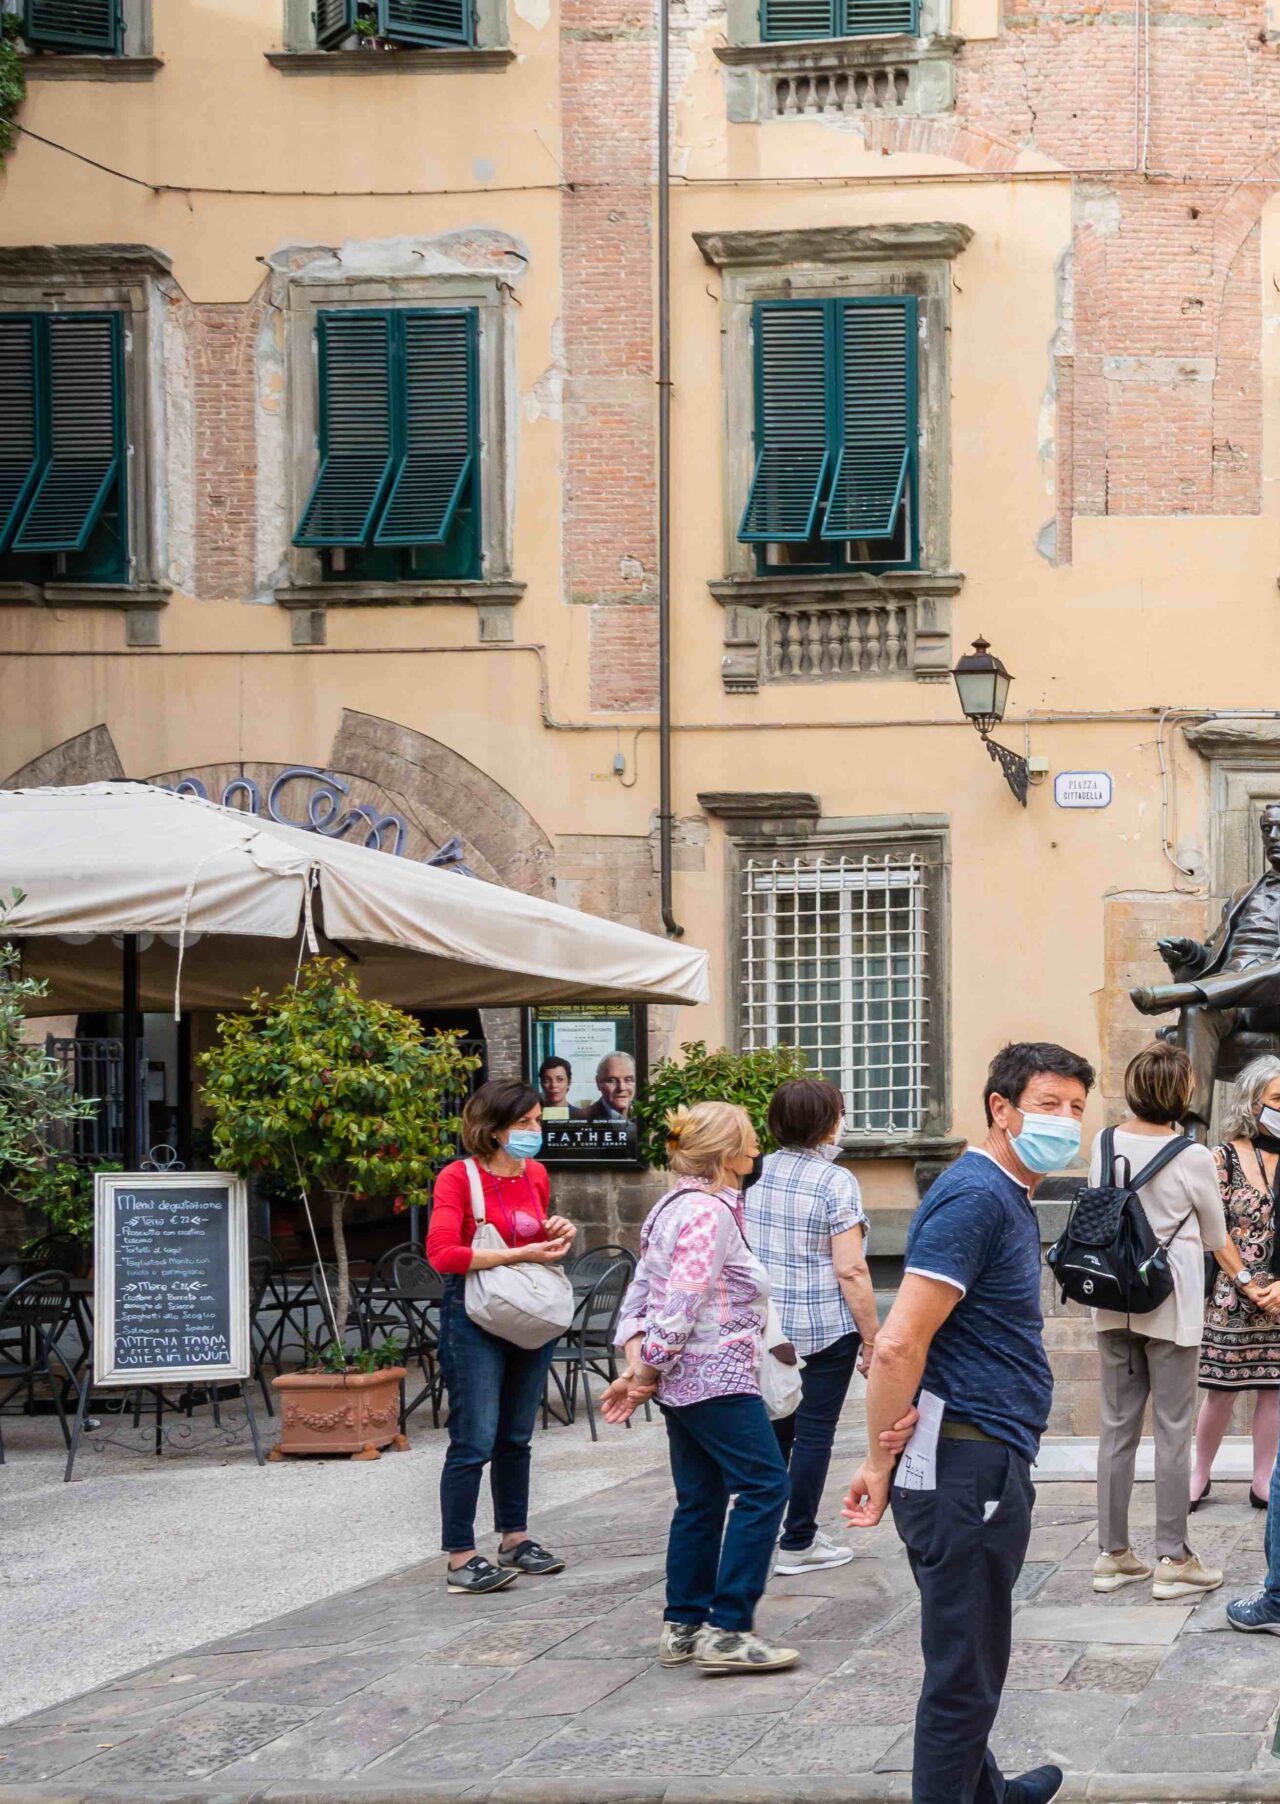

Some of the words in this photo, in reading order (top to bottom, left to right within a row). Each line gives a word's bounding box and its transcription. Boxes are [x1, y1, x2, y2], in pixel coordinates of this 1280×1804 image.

[1068, 780, 1097, 789] PIAZZA
[1063, 792, 1103, 800] CITTADELLA
[547, 1132, 628, 1142] FATHER
[158, 1200, 224, 1213] degustazione
[138, 1281, 168, 1291] Mare
[121, 1312, 161, 1322] Spaghetti
[122, 1325, 160, 1335] Salmone
